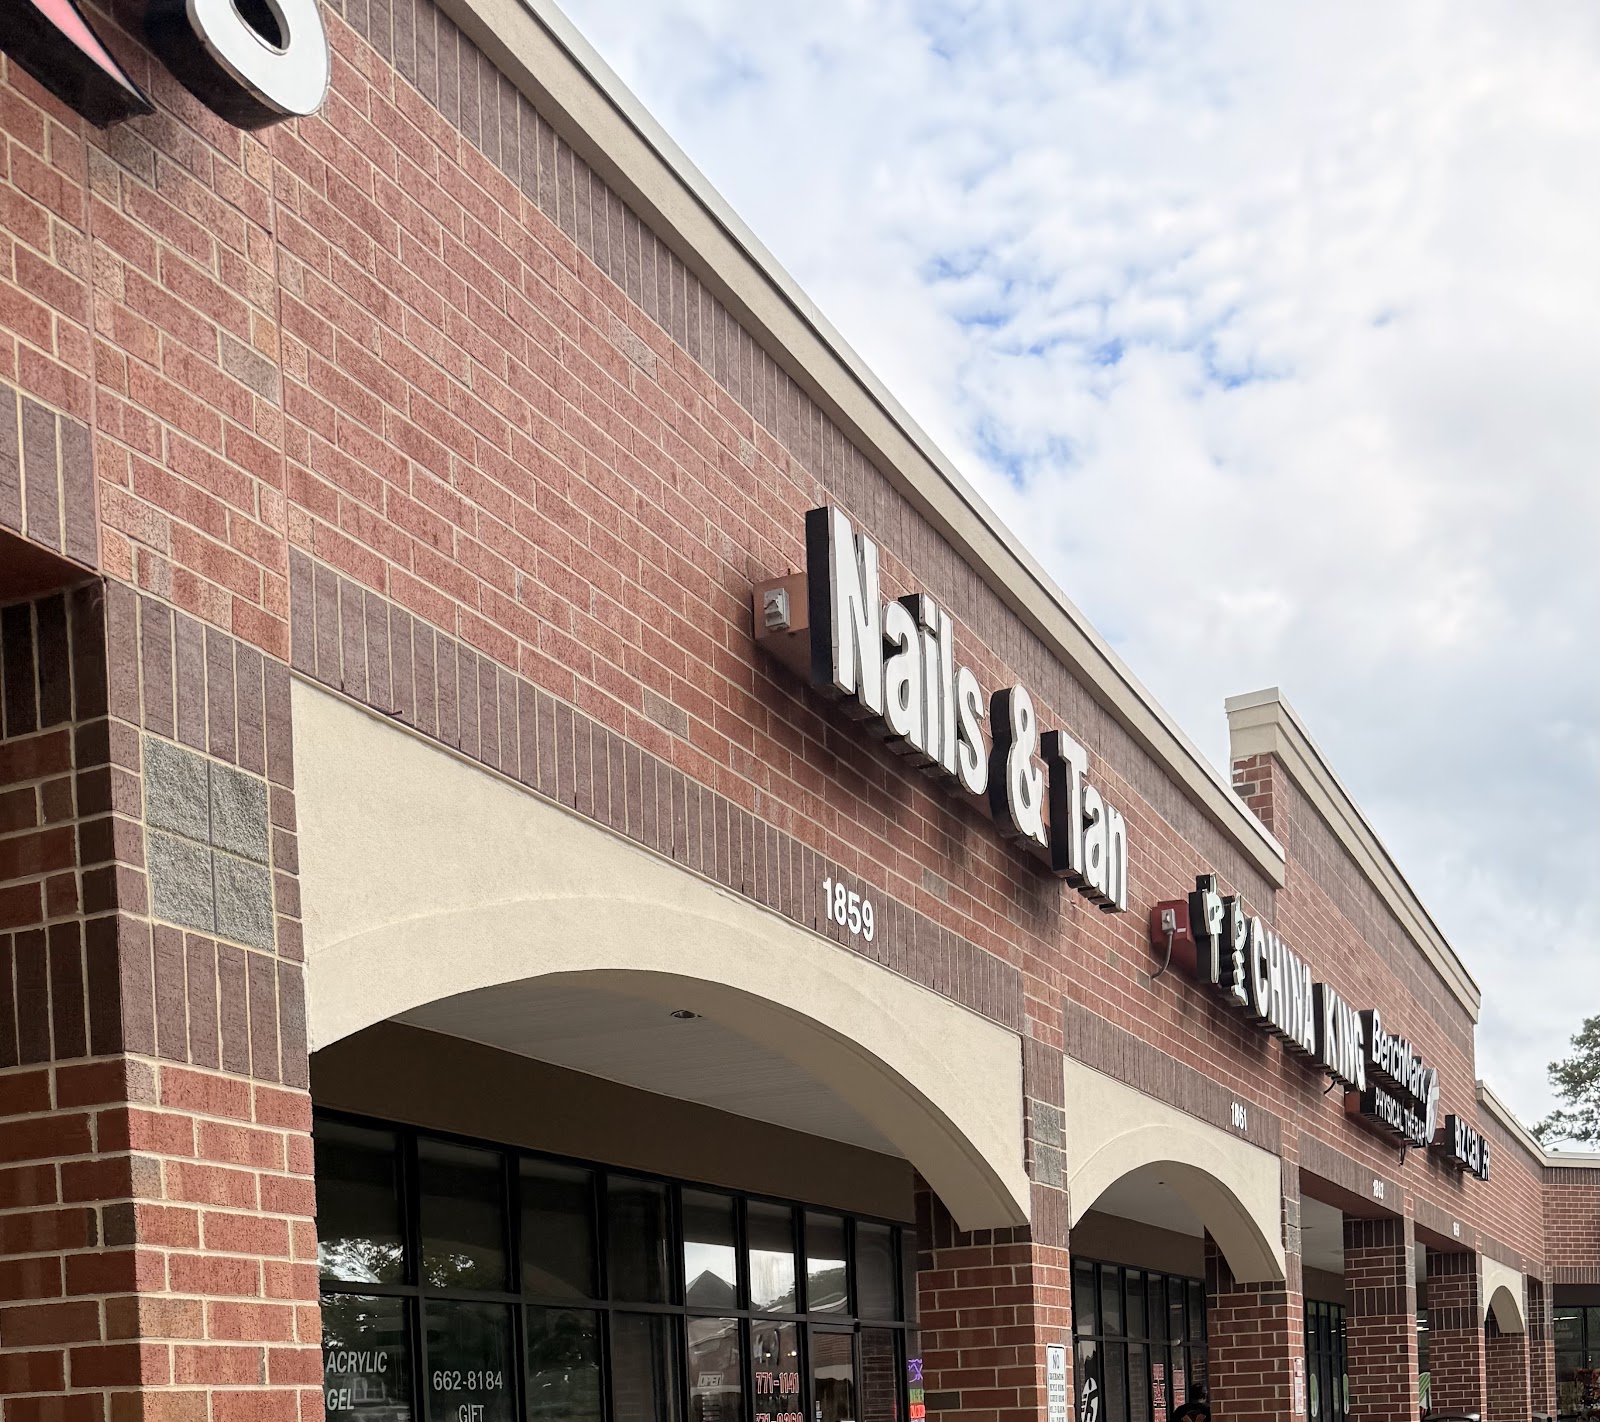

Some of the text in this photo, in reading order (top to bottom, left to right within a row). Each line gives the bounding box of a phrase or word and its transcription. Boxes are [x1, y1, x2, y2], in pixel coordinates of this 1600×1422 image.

[827, 502, 1128, 913] Nails & Tan
[822, 877, 874, 942] 1859
[1251, 916, 1367, 1093] CHINA KING
[1372, 1008, 1426, 1104] BenchMark
[1230, 1101, 1248, 1132] 1861
[326, 1351, 388, 1374] ACRYLIC
[432, 1370, 503, 1391] 662-8184
[755, 1372, 800, 1395] 771-1141
[327, 1388, 354, 1411] GEL
